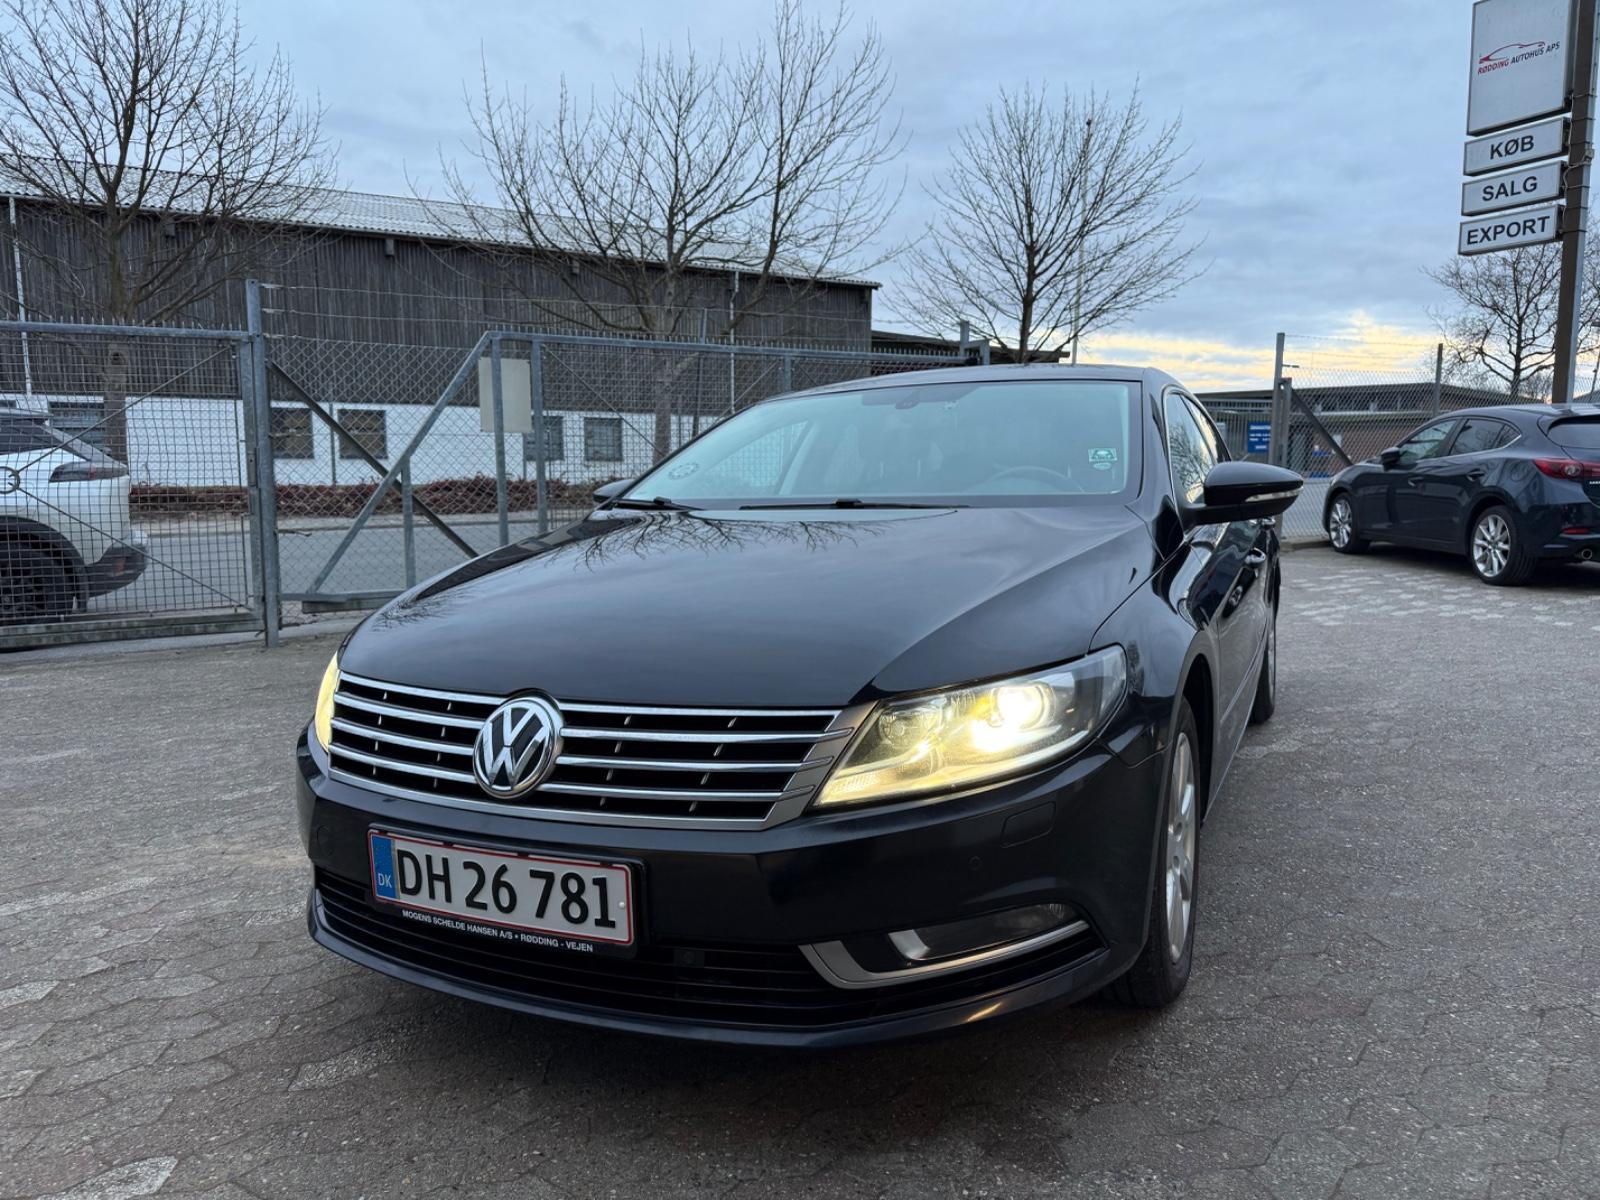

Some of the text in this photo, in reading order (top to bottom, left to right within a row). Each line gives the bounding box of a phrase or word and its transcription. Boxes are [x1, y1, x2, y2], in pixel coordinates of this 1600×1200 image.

[1477, 41, 1560, 75] RØDDING AUTOHUS APS
[1489, 135, 1535, 160] KØB
[1481, 176, 1538, 202] SALG
[1466, 215, 1550, 246] EXPORT
[377, 873, 392, 889] DK
[397, 848, 616, 929] DH 26 781
[402, 909, 594, 953] MOGENS SCHELDE HANSEN A/S RØDDING VEJEN
